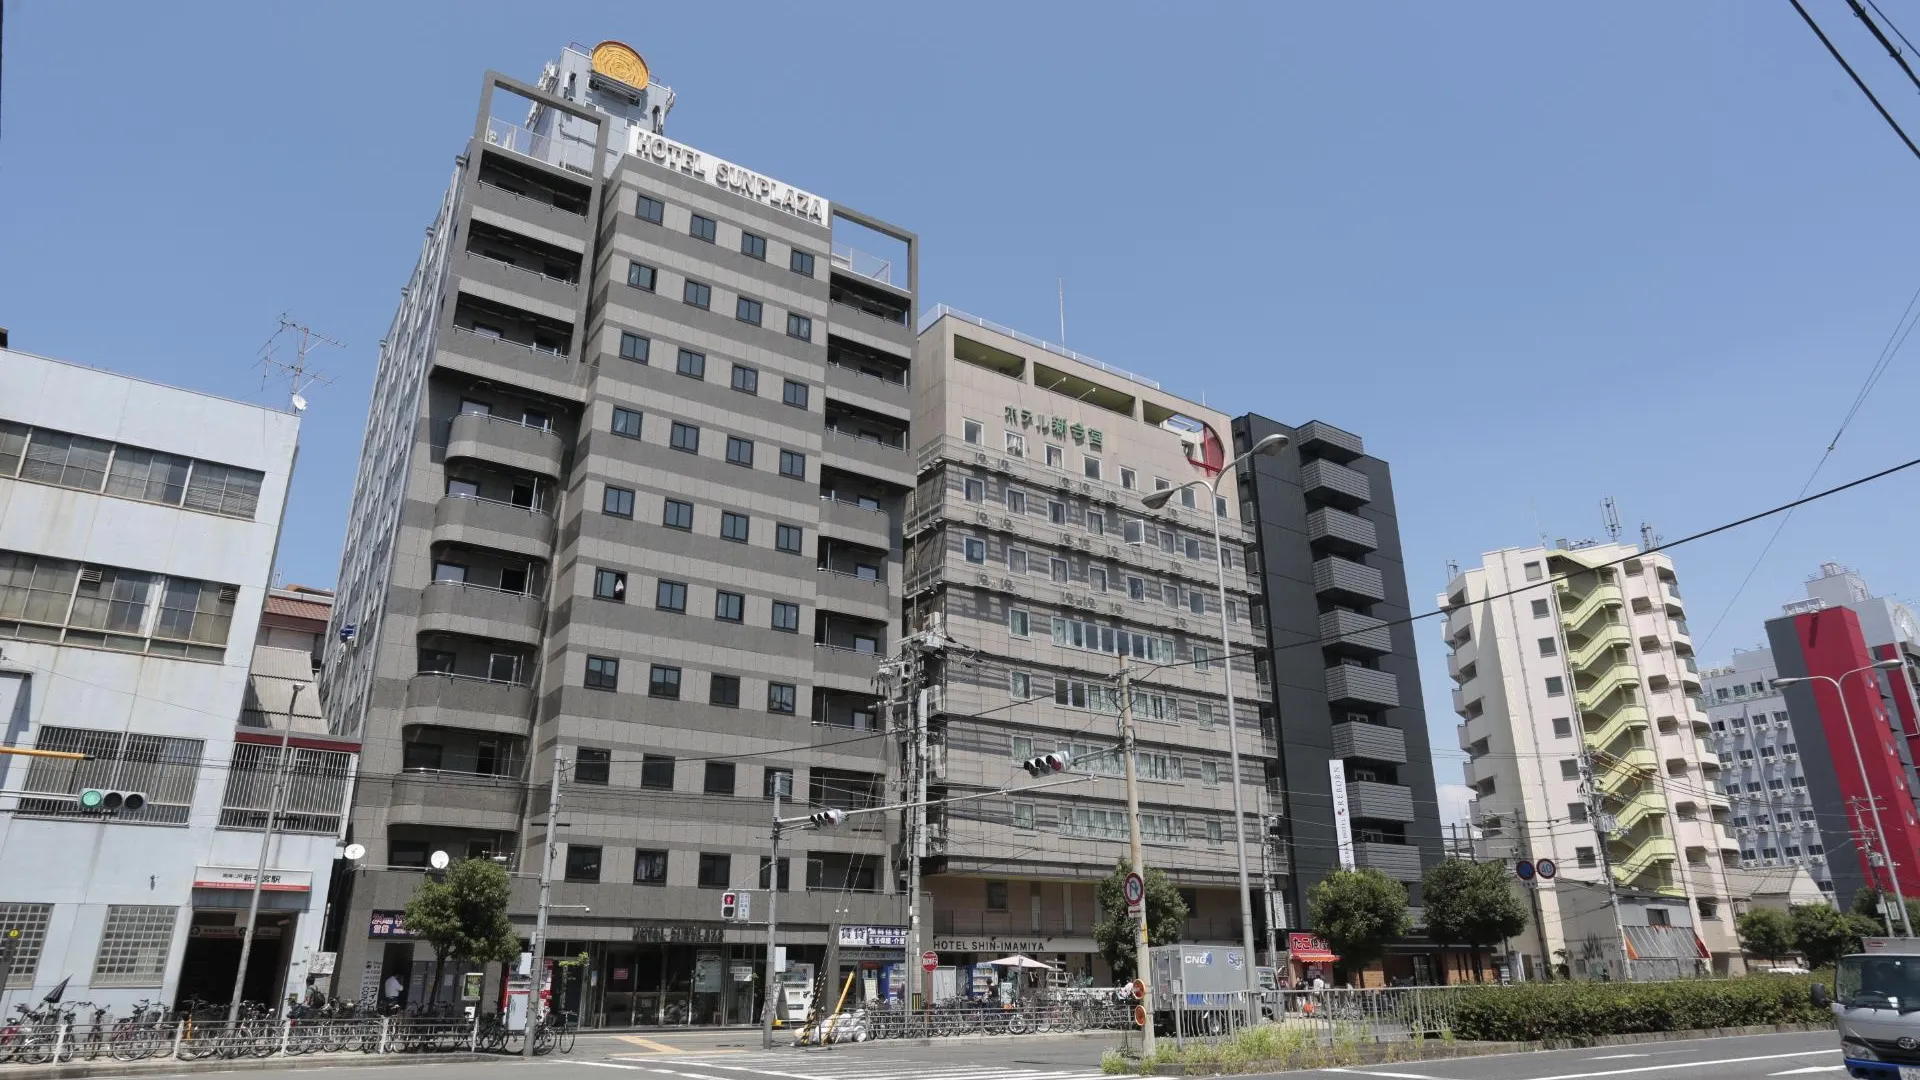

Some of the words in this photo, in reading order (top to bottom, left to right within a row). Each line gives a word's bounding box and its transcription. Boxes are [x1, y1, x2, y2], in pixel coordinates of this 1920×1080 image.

[637, 132, 706, 177] HOTEL
[715, 163, 823, 222] SUNPLAZA
[1004, 405, 1103, 446] ホテル新今宮
[1333, 766, 1345, 806] REBORN
[933, 940, 968, 951] HOTEL
[971, 941, 1045, 951] SHIN-IMAMIYA
